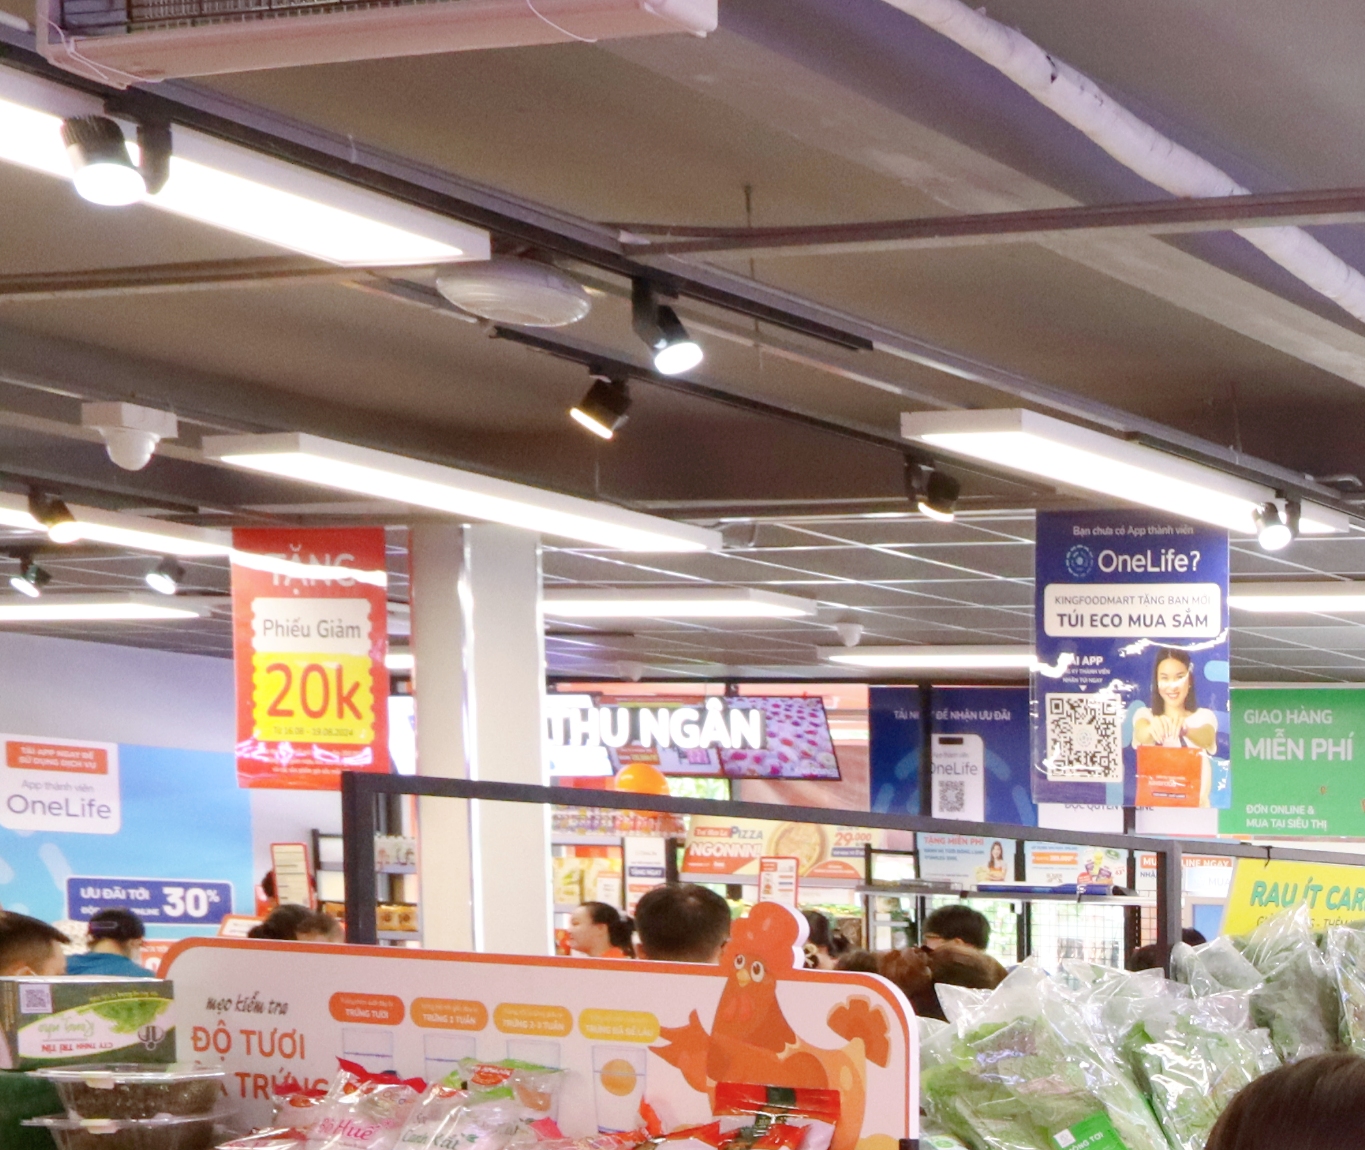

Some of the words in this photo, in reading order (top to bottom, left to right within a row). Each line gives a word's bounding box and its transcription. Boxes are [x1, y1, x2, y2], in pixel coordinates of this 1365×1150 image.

[1115, 526, 1125, 536] có
[1128, 526, 1146, 537] App
[265, 543, 357, 595] TẶNG
[1098, 548, 1201, 573] OneLife?
[1055, 595, 1136, 606] KINGFOODMART
[263, 617, 311, 638] Phiếu
[317, 618, 361, 639] Giảm
[1057, 609, 1084, 628] TÚI
[1090, 613, 1123, 628] ECO
[1128, 613, 1166, 628] MUA
[1082, 656, 1103, 666] APP
[265, 662, 363, 720] 20k
[546, 707, 630, 748] THU
[639, 697, 763, 750] NGÂN
[1244, 709, 1283, 724] GIAO
[1285, 705, 1333, 725] HÀNG
[1244, 728, 1304, 761] MIỄN
[1311, 731, 1355, 761] PHÍ
[22, 779, 40, 791] App
[43, 780, 71, 792] thành
[6, 794, 112, 820] OneLife
[1246, 803, 1268, 815] ĐƠN
[1270, 804, 1306, 816] ONLINE
[1307, 805, 1315, 816] &
[731, 826, 763, 840] PIZZA
[1246, 818, 1268, 829] MUA
[1270, 818, 1286, 830] TẠI
[1287, 815, 1310, 830] SIÊU
[1311, 819, 1328, 832] THỊ
[1143, 856, 1157, 866] MU
[162, 886, 221, 918] 30%
[1250, 880, 1298, 908] RAU
[1302, 877, 1323, 906] ÍT
[206, 997, 233, 1012] mẹo
[234, 991, 266, 1013] kiểm
[191, 1019, 232, 1061] ĐỘ
[240, 1026, 306, 1060] TƯƠI
